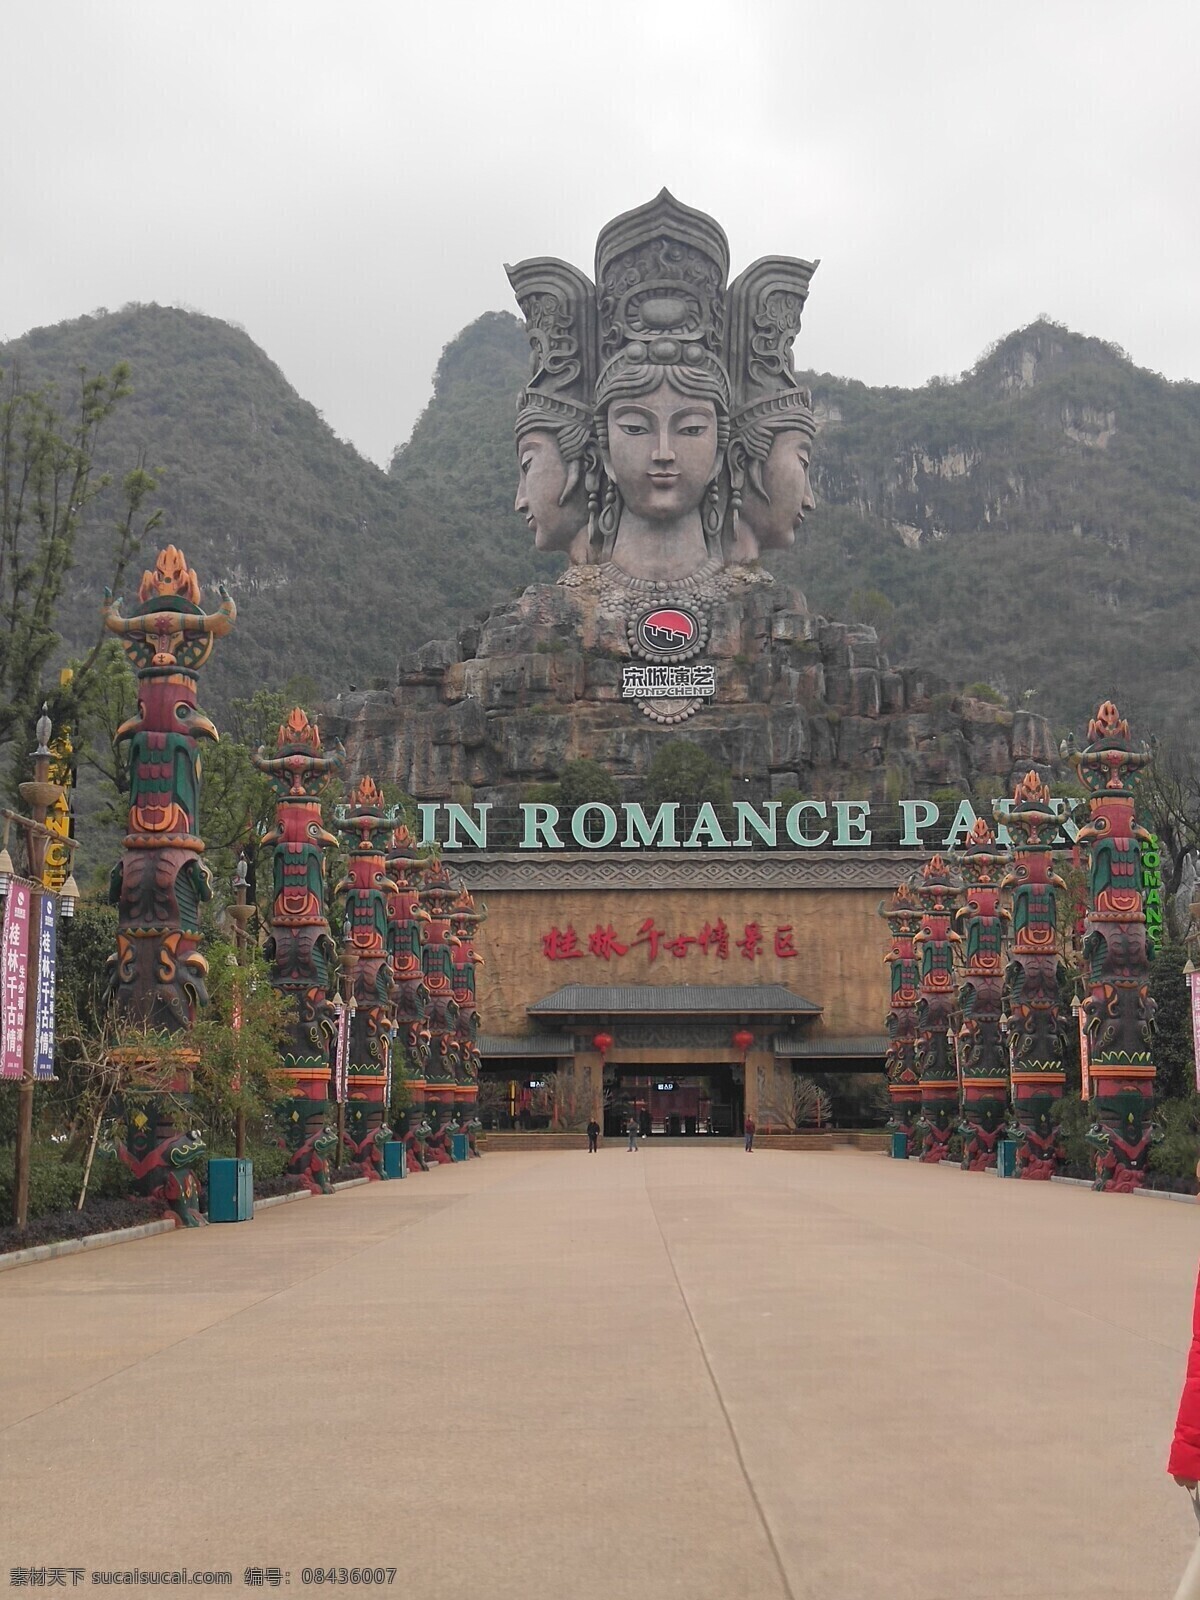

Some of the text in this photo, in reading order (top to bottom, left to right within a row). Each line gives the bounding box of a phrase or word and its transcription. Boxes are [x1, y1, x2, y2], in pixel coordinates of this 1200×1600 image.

[622, 665, 715, 688] 宋城演艺
[622, 685, 715, 698] SONGCHENG
[518, 800, 872, 848] ROMANCE
[542, 917, 799, 963] 桂林千古情景区
[6, 922, 21, 1053] 桂林千古情
[40, 930, 51, 1055] 桂林千古情
